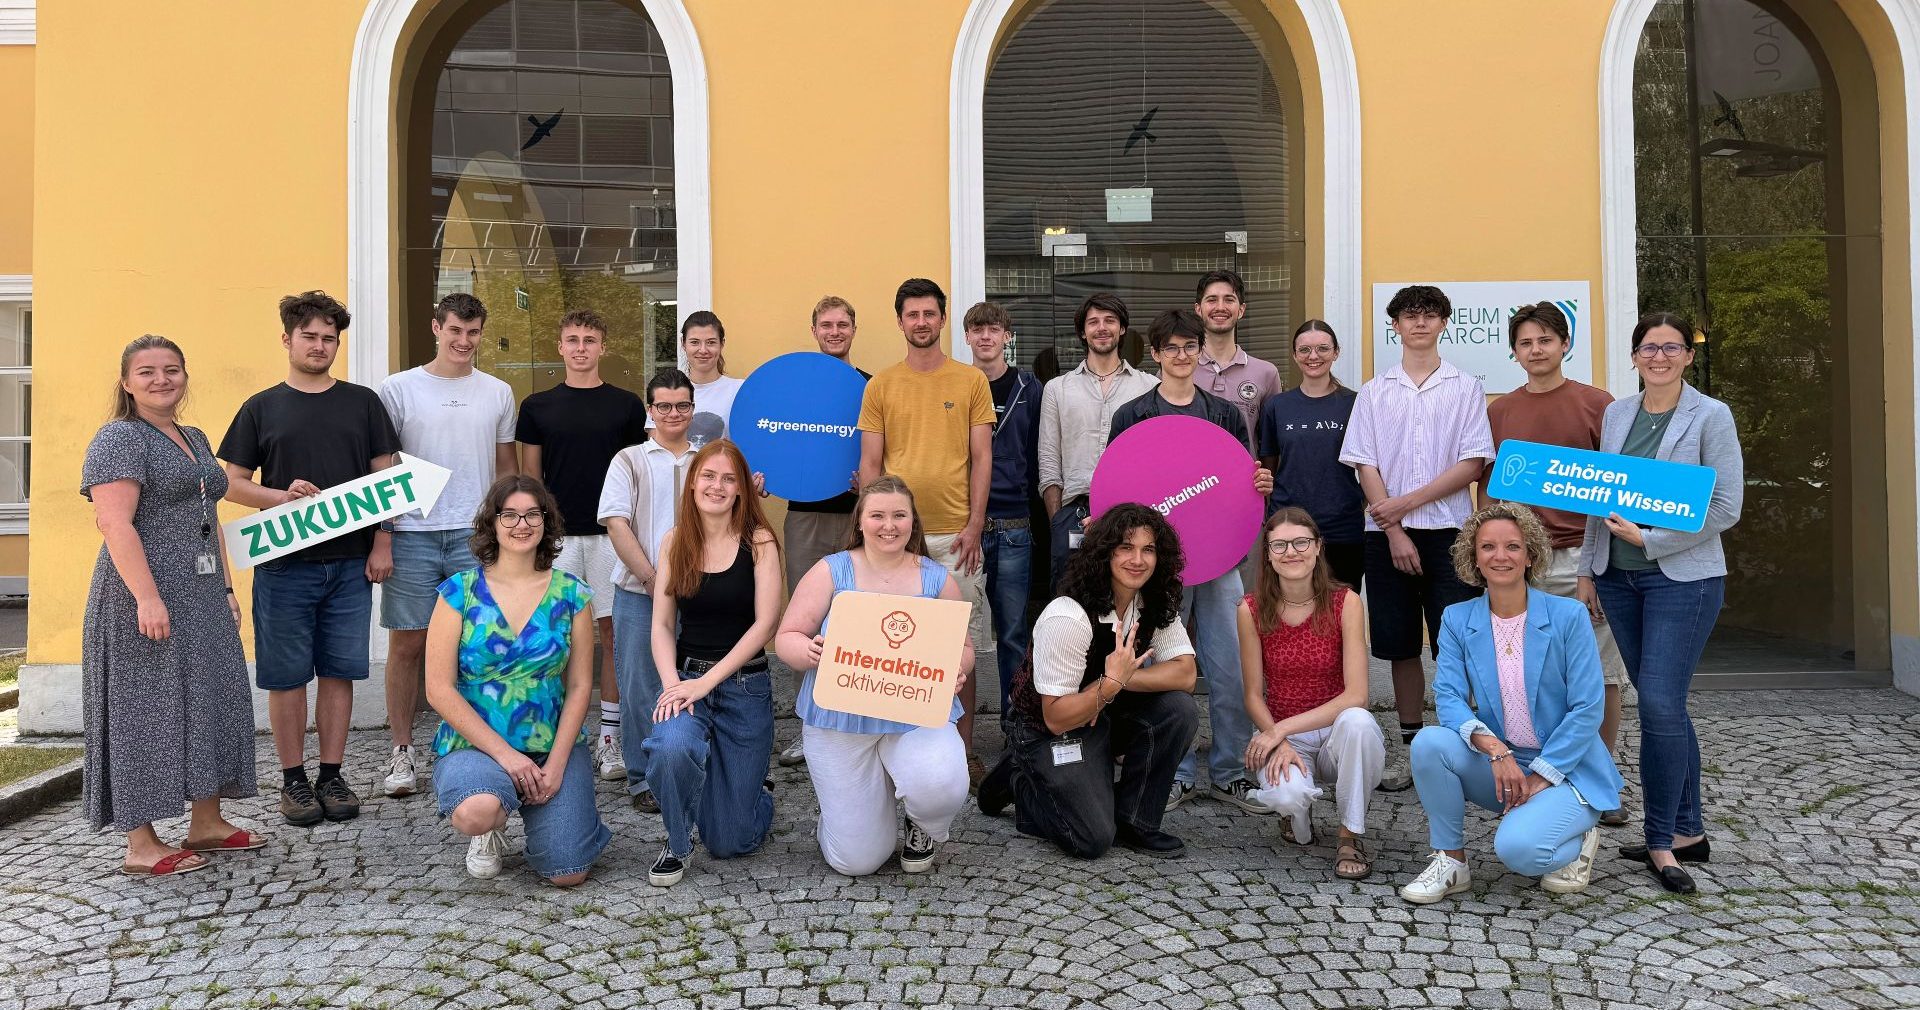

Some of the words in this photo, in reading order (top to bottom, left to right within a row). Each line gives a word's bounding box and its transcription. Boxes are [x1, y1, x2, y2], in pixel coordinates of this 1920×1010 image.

[1386, 327, 1500, 344] RARCH
[756, 418, 857, 438] #greenenergy
[1546, 459, 1628, 486] Zuhören
[1150, 475, 1220, 517] igitaltwin
[1541, 481, 1612, 504] schafft
[1617, 489, 1696, 518] Wissen.
[239, 471, 416, 559] ZUKUNFT
[834, 646, 945, 683] Interaktion
[837, 671, 934, 703] aktivieren!
